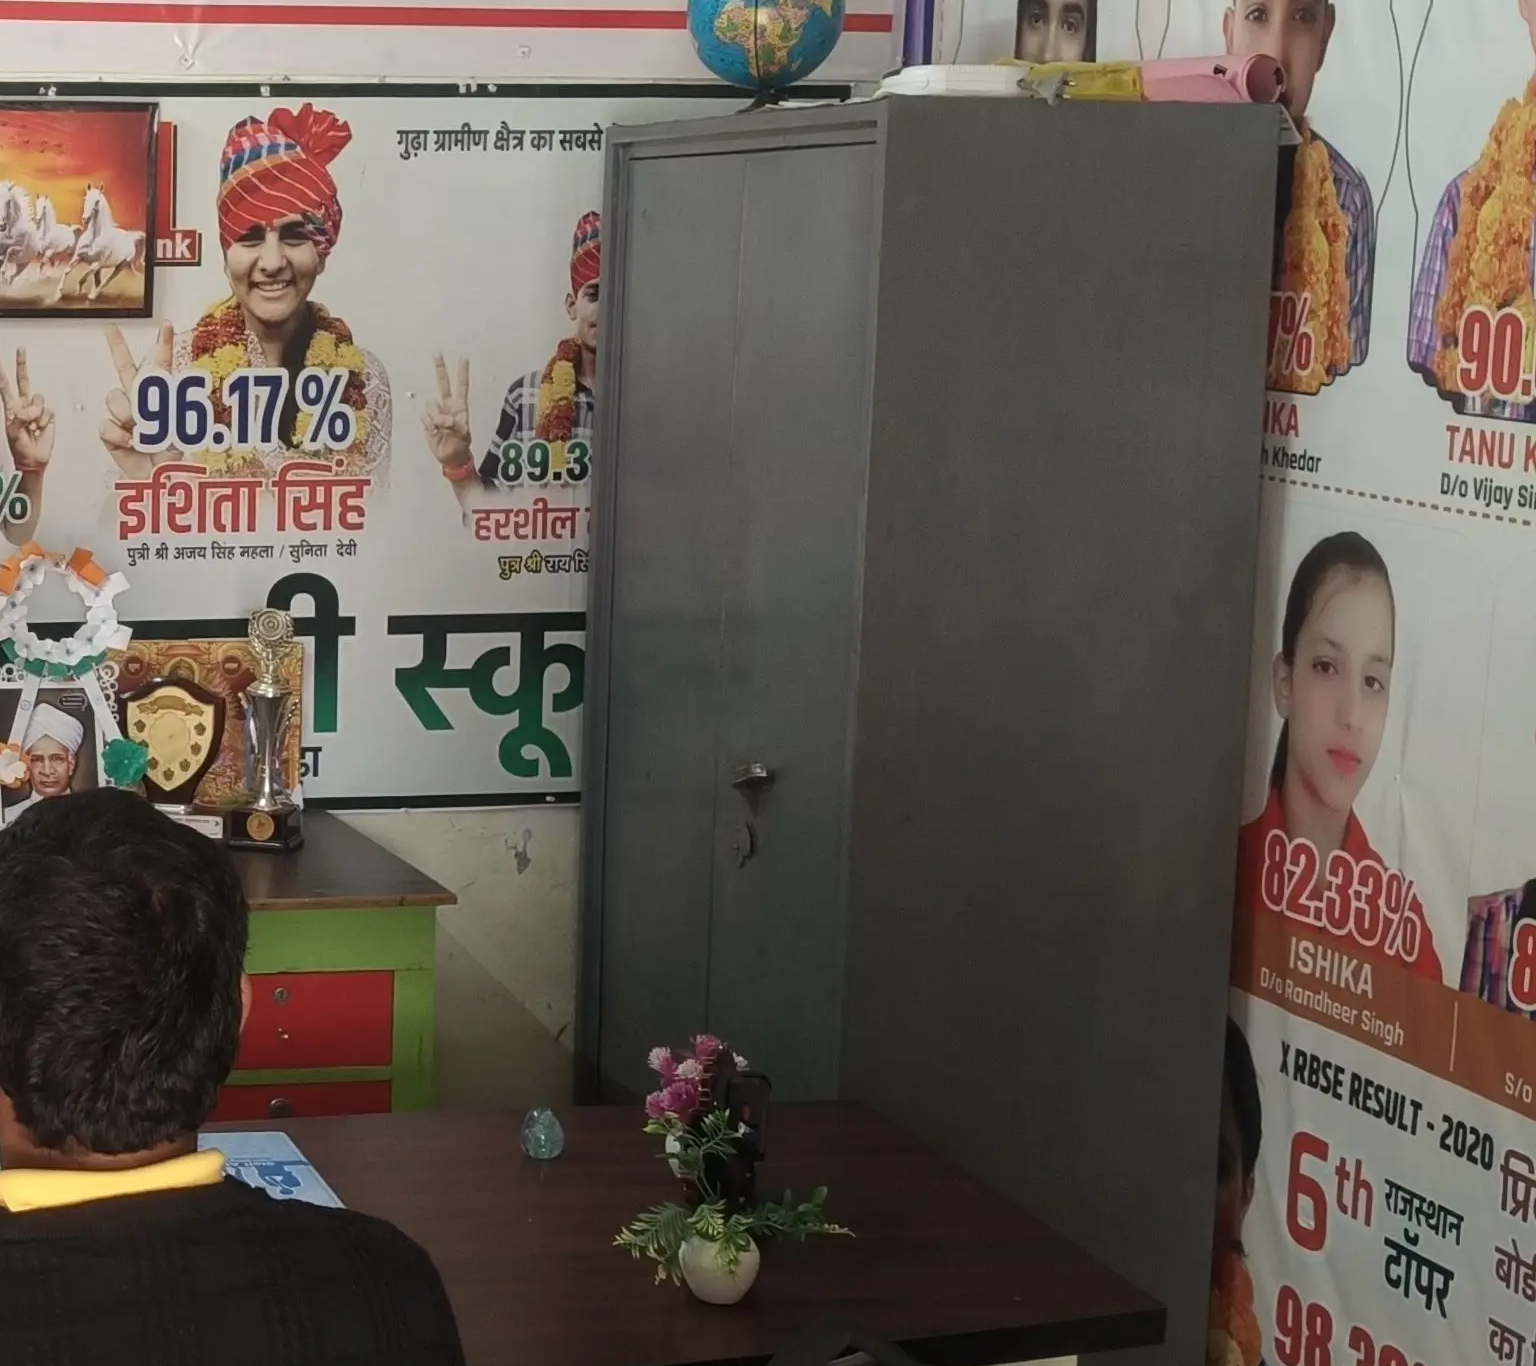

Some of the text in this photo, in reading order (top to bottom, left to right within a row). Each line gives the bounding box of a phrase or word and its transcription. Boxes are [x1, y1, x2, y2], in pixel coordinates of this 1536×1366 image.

[433, 121, 490, 152] ग्रामीण
[529, 128, 555, 152] का
[558, 121, 604, 152] सबसे
[1460, 308, 1536, 397] 90.
[137, 373, 351, 446] 96.17 %
[1272, 445, 1322, 473] Khedar
[1445, 424, 1516, 469] TANU
[115, 458, 371, 541] इशिता सिंह
[472, 497, 580, 541] हरशील
[1440, 472, 1536, 512] D/o Vijay Si
[126, 542, 150, 566] पुत्री
[154, 542, 169, 562] श्री
[173, 546, 207, 561] अजय
[211, 541, 236, 561] सिंह
[239, 545, 274, 560] महला
[289, 539, 328, 563] सुनिता
[336, 538, 358, 557] देवी
[498, 555, 522, 580] पुत्र
[524, 549, 542, 573] श्री
[544, 554, 573, 573] राय
[1262, 829, 1421, 963] 82.33%
[1289, 936, 1373, 1000] ISHIKA
[1260, 967, 1404, 1046] D/o Randheer Singh
[1279, 1039, 1292, 1077] X
[1293, 1048, 1345, 1101] RBSE
[1348, 1071, 1423, 1136] RESULT
[1439, 1113, 1495, 1172] 2020
[1384, 1177, 1464, 1247] राजस्थान
[1384, 1227, 1455, 1320] टॉपर
